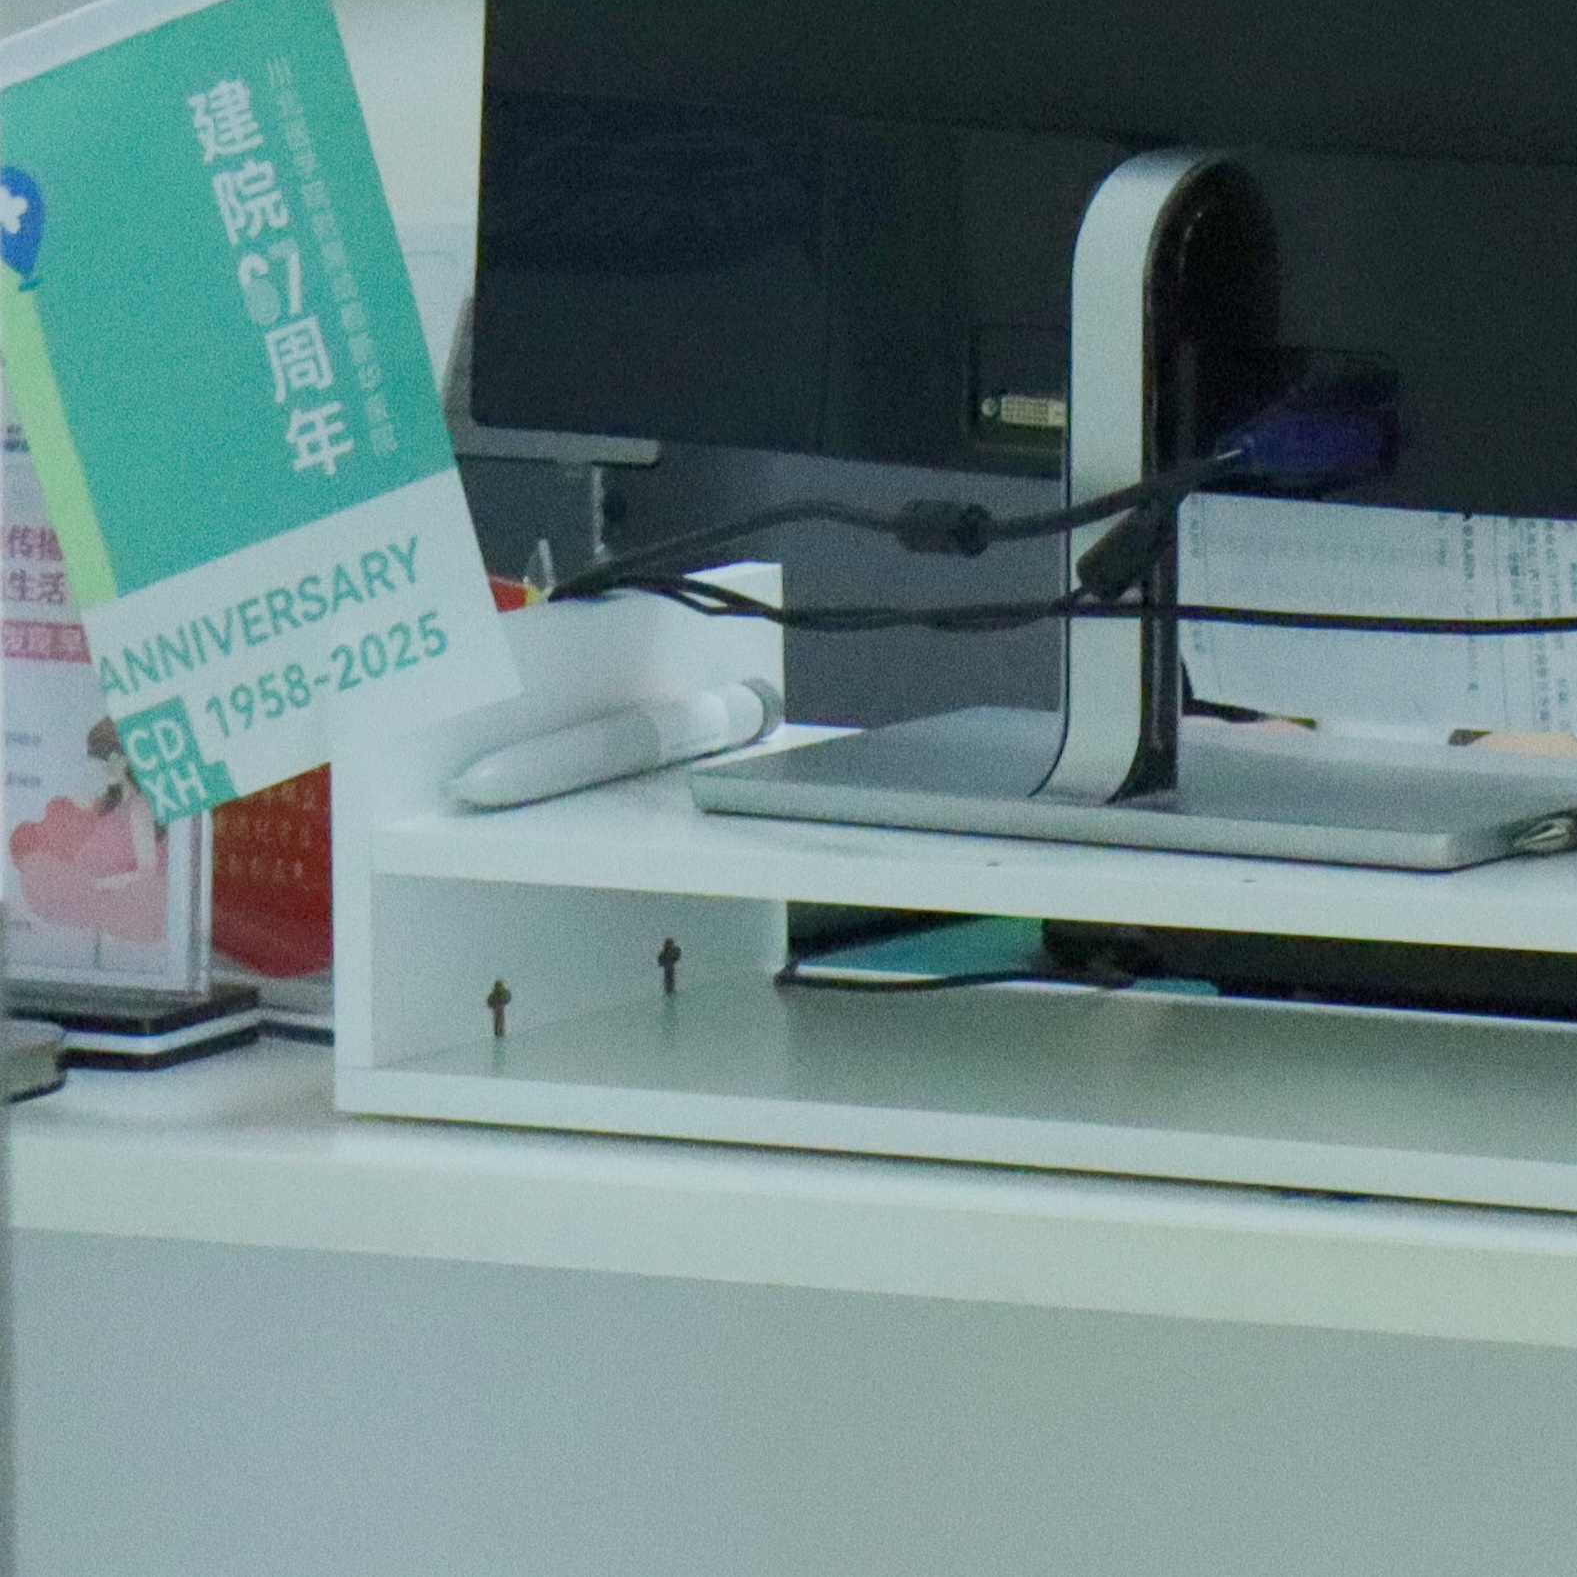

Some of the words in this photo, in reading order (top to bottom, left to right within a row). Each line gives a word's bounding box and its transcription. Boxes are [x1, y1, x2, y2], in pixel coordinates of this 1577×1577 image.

[98, 536, 419, 698] ANNIVERSARY
[205, 610, 450, 740] 1958-2025
[126, 717, 186, 771] CD
[142, 762, 208, 824] XH
